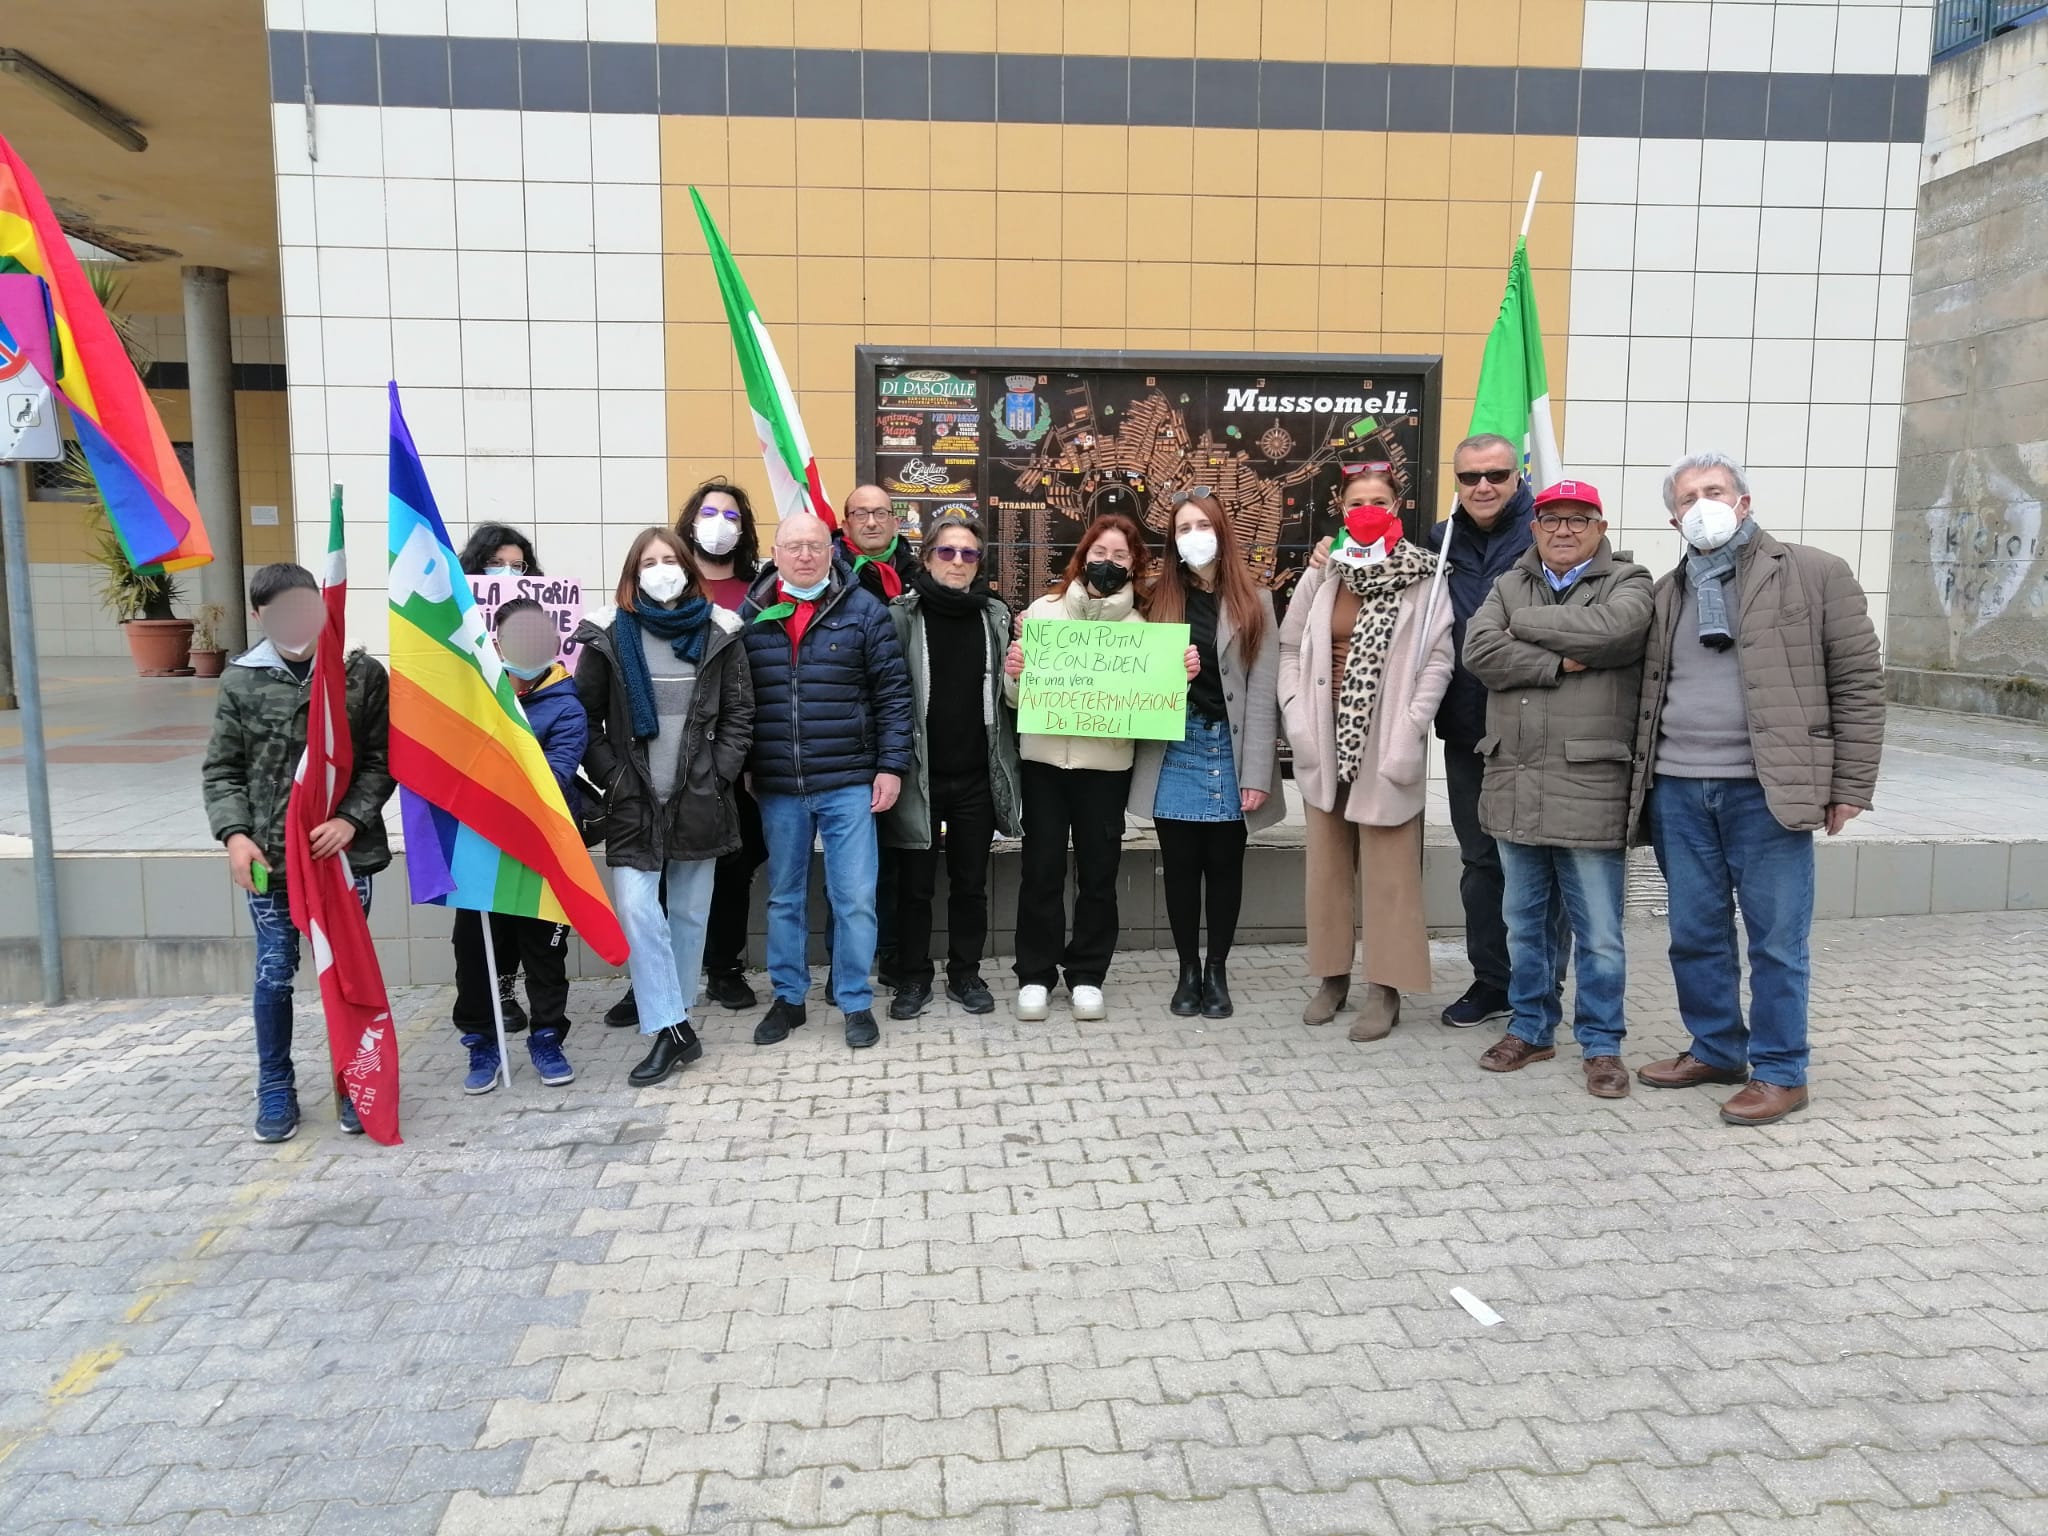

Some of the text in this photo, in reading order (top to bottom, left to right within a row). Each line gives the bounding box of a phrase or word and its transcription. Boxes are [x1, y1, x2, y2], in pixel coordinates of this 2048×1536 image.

[881, 381, 975, 397] DI PASQUALE
[1224, 388, 1408, 414] Mussomeli
[883, 426, 916, 438] Mappa
[998, 502, 1046, 510] STRADARIO
[473, 581, 501, 606] LA
[1057, 625, 1091, 648] CON
[1053, 651, 1087, 671] CON
[1026, 672, 1041, 686] Per
[1045, 676, 1064, 687] una
